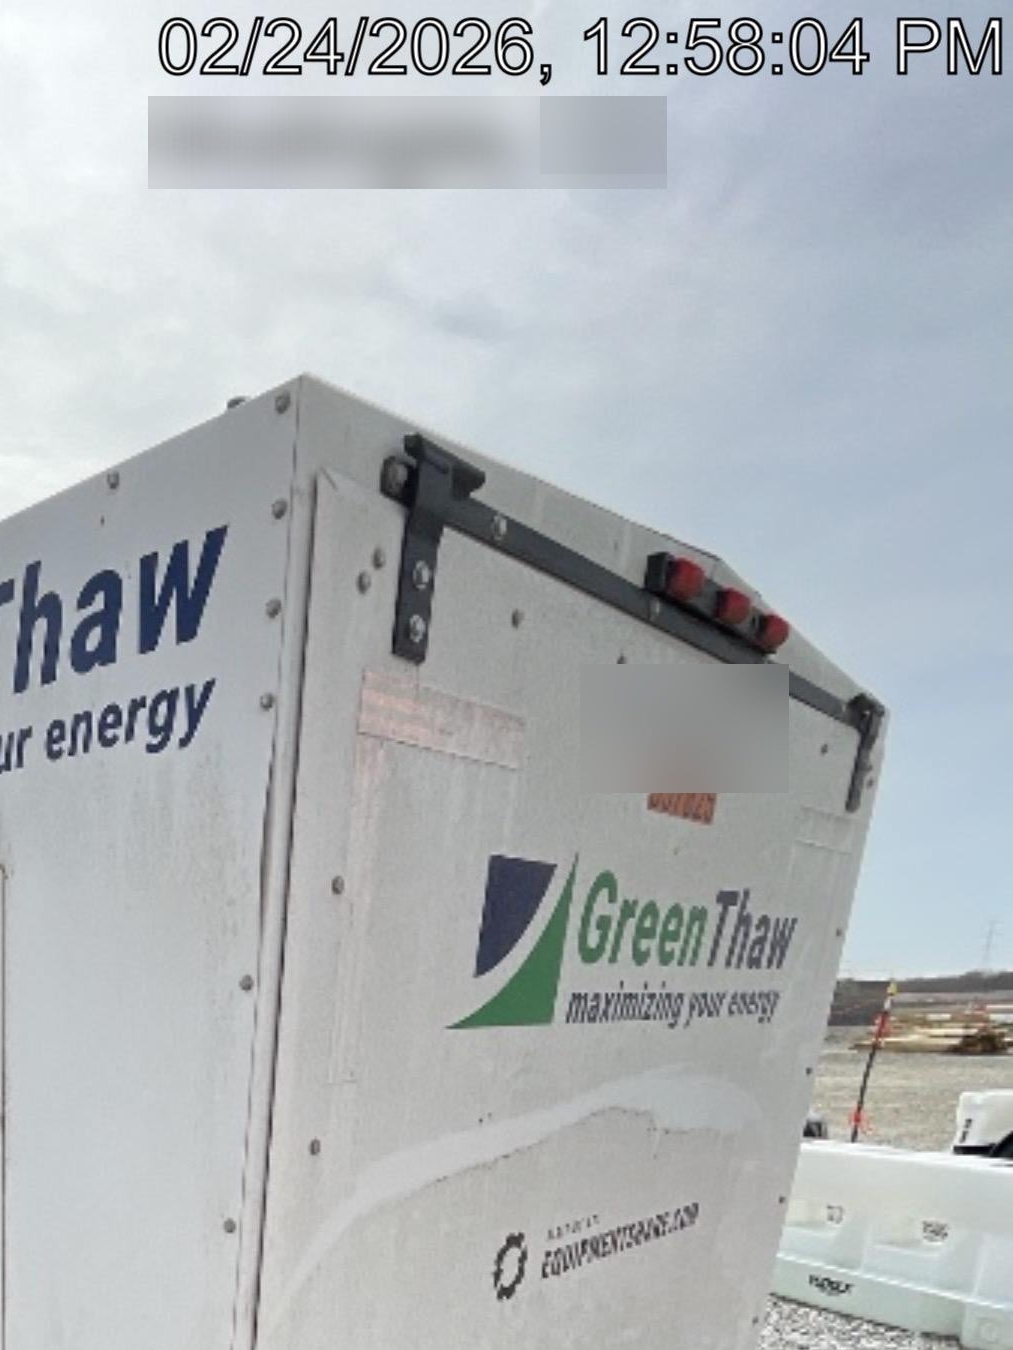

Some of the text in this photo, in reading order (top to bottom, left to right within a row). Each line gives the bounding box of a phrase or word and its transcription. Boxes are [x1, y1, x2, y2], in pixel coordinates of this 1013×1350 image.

[45, 678, 216, 761] energy
[565, 980, 781, 1029] maximizing your energy
